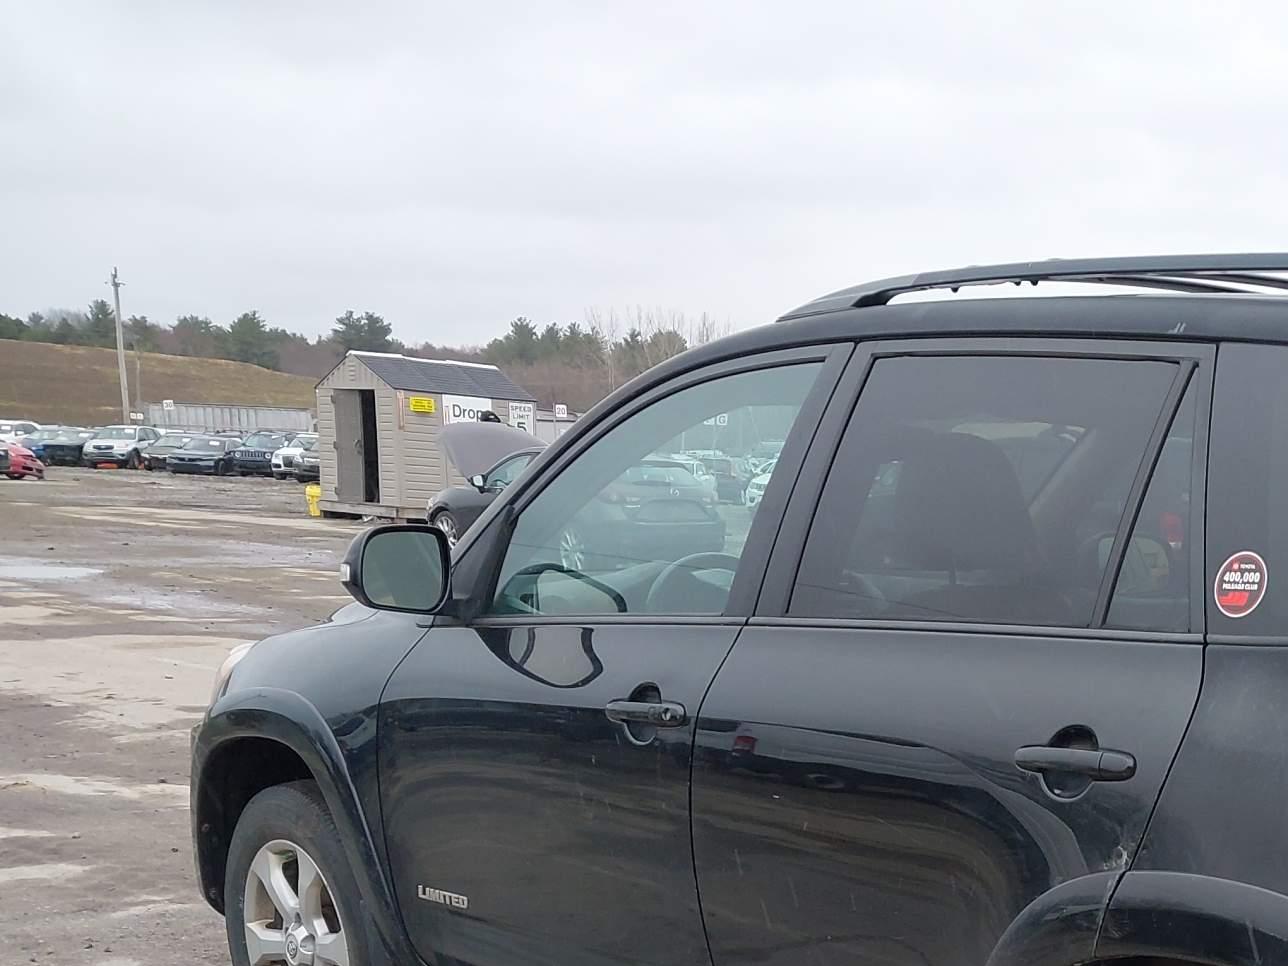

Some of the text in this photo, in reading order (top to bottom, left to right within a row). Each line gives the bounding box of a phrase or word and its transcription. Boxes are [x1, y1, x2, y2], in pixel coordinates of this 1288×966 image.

[510, 405, 532, 413] SPEED
[556, 406, 566, 415] 20
[1223, 572, 1260, 583] 400,000
[417, 884, 468, 909] LIMITED
